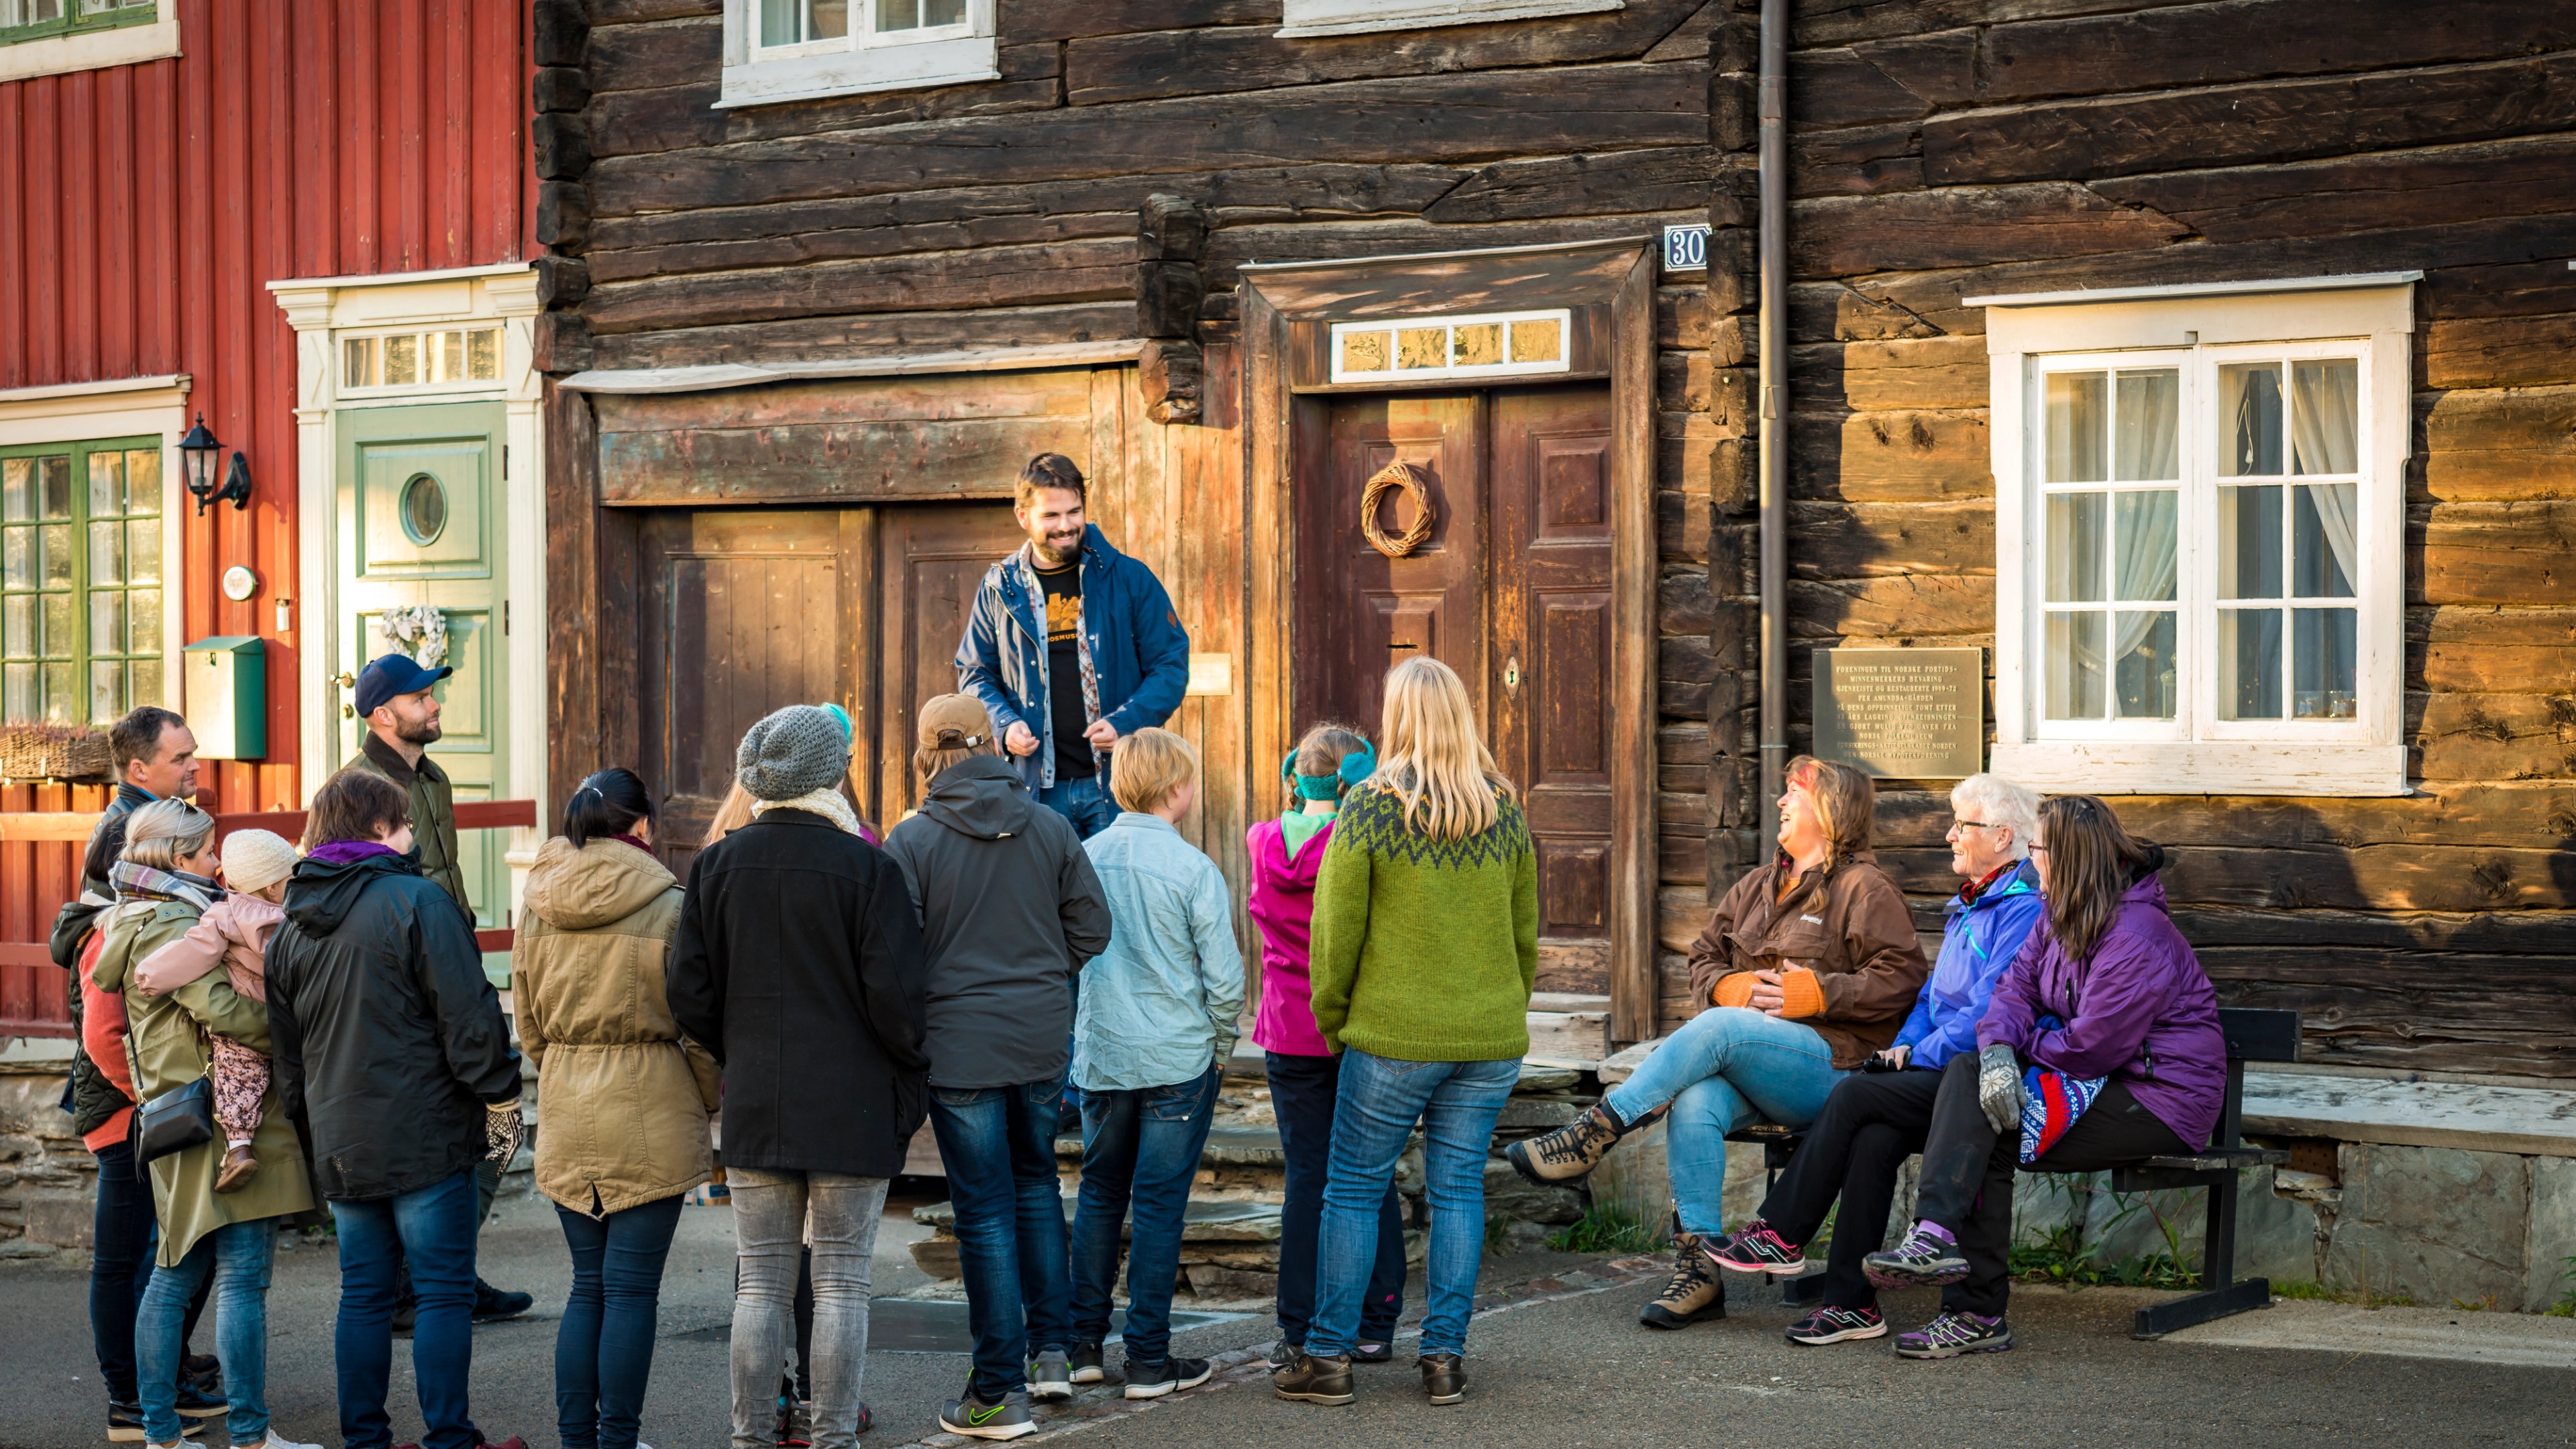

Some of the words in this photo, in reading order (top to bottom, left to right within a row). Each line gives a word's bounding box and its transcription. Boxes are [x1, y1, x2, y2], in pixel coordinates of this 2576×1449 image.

[1673, 231, 1704, 264] 30
[1874, 694, 1933, 702] AMUNDSA-GÅRDEN
[1837, 703, 1845, 711] PÅ
[1848, 712, 1861, 720] ÅRS
